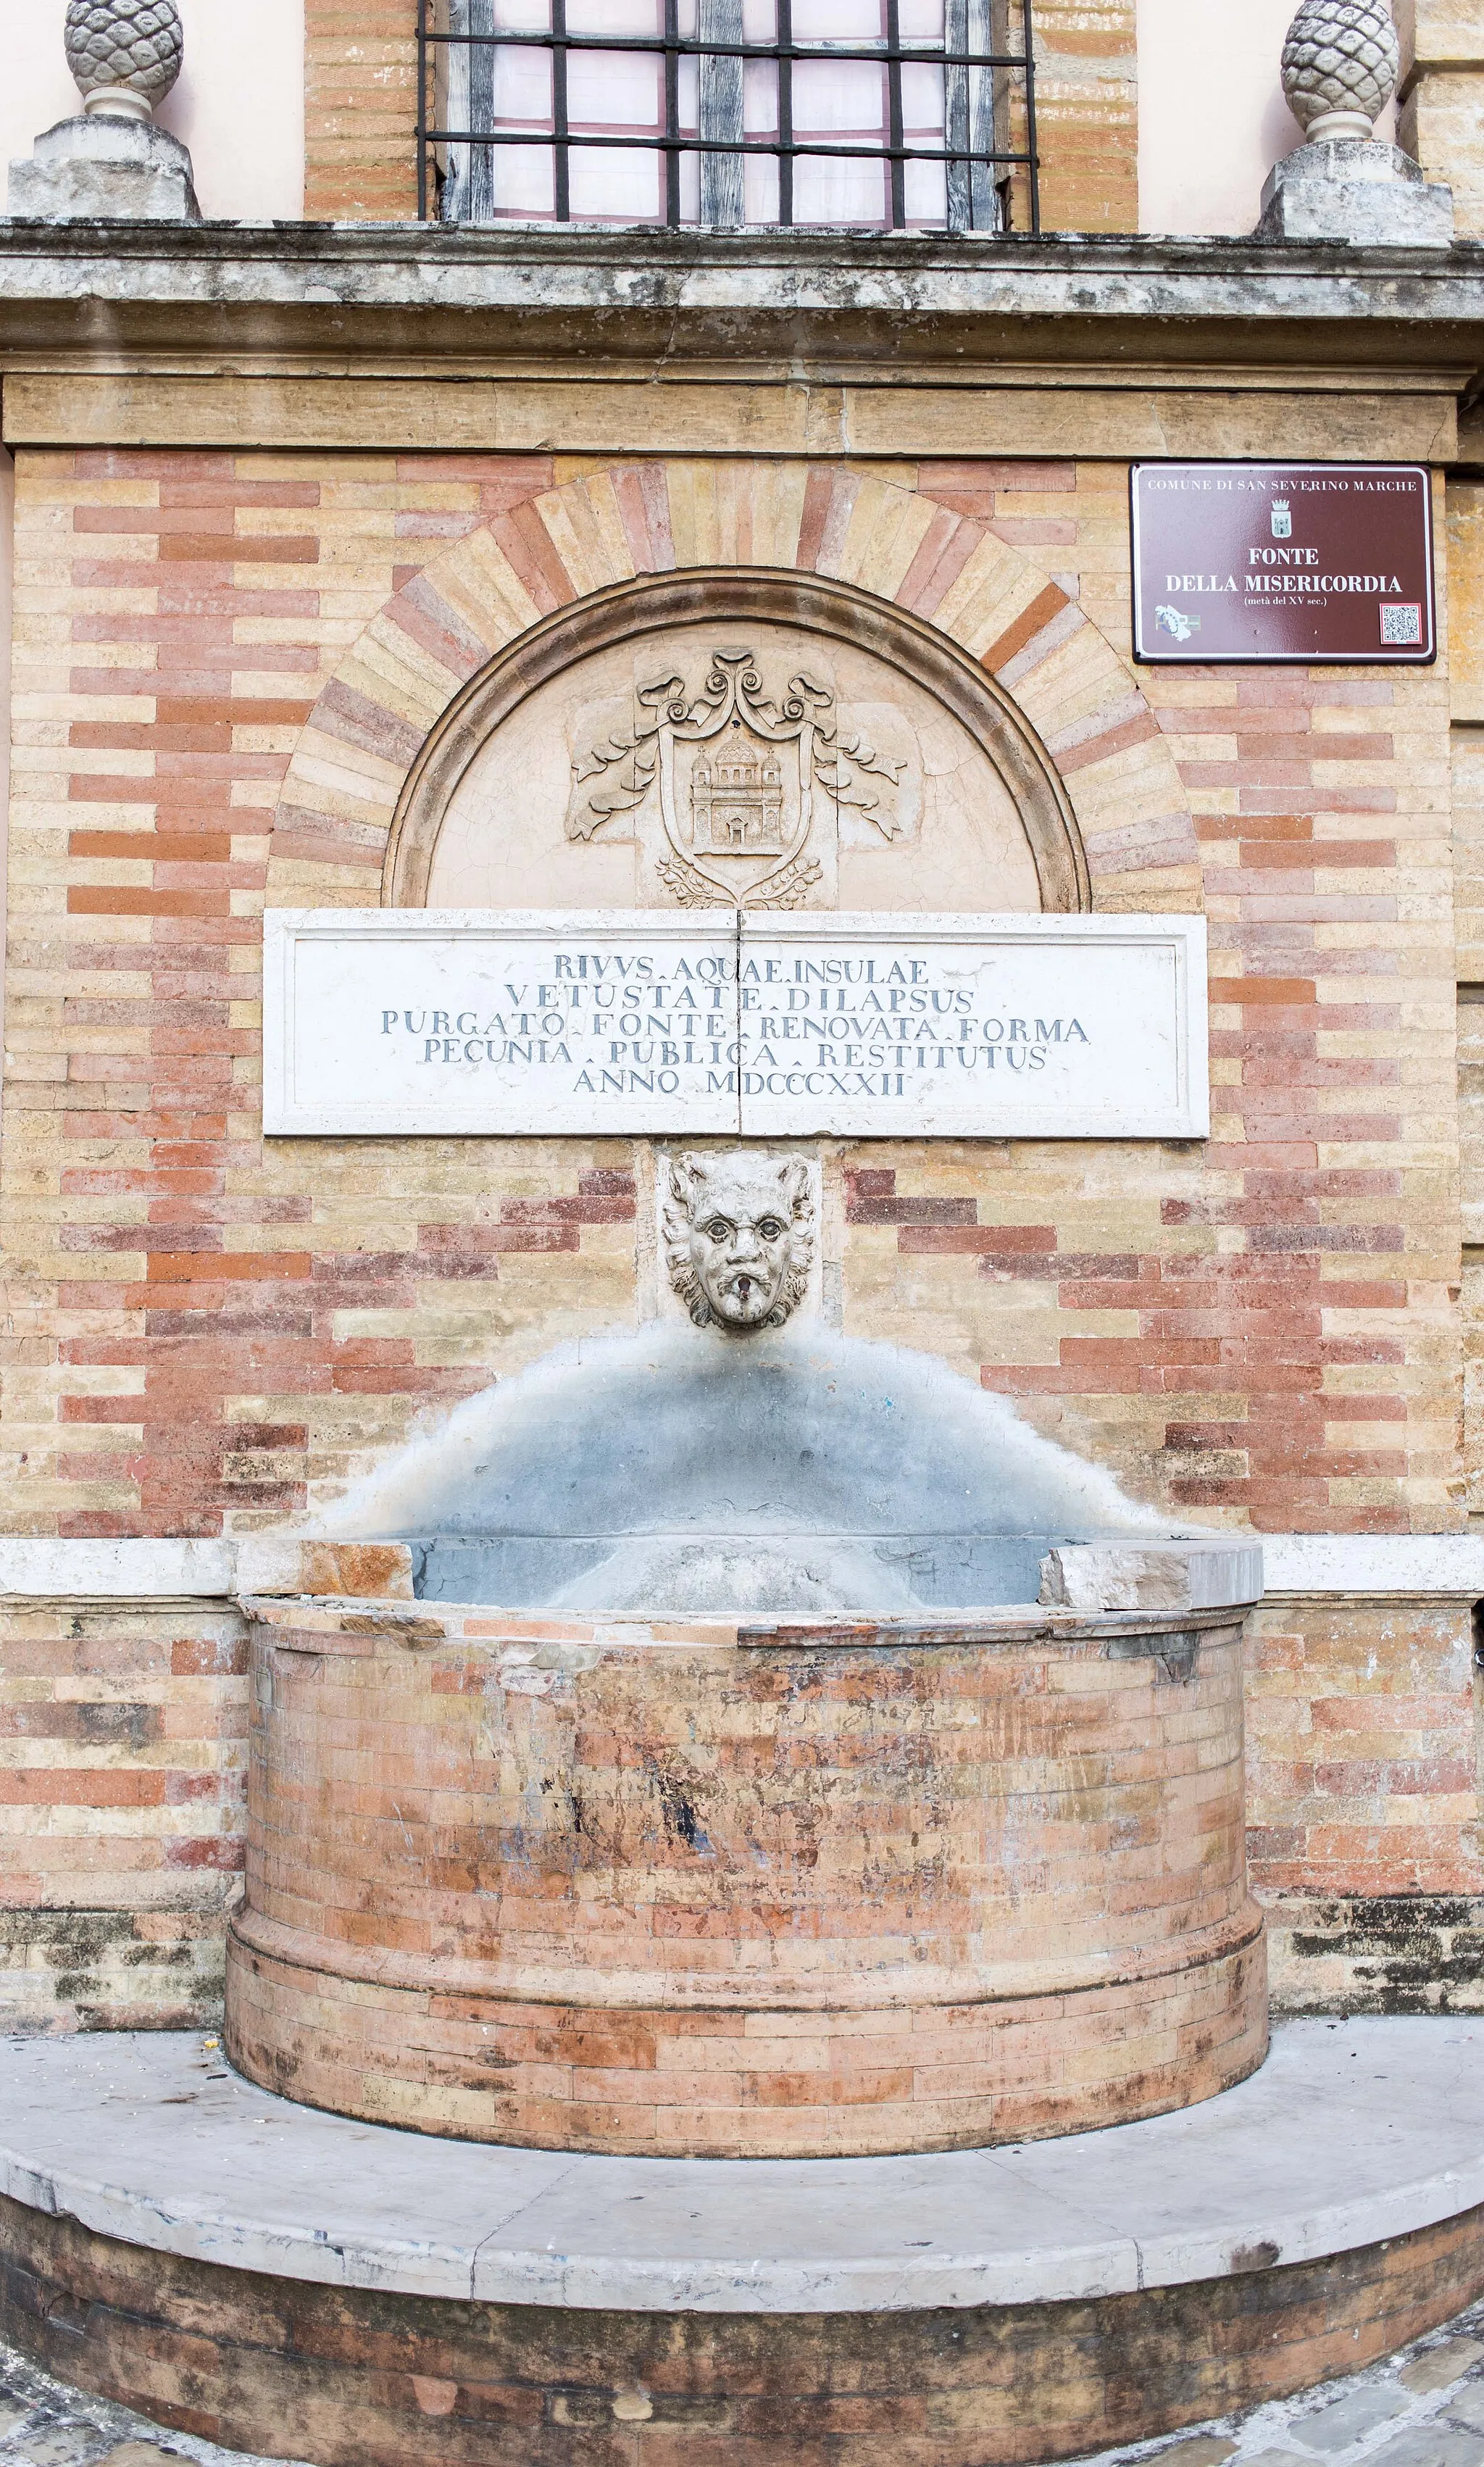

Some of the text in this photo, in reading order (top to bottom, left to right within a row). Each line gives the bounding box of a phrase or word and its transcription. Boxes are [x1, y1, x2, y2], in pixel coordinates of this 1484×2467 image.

[1148, 480, 1417, 492] COMUNE DI SAN SEVERINO MARCHE
[1248, 548, 1320, 565] FONTE
[1165, 575, 1404, 593] DELLA MISERICORDIA
[1243, 596, 1327, 607] (metà del XV sec.)
